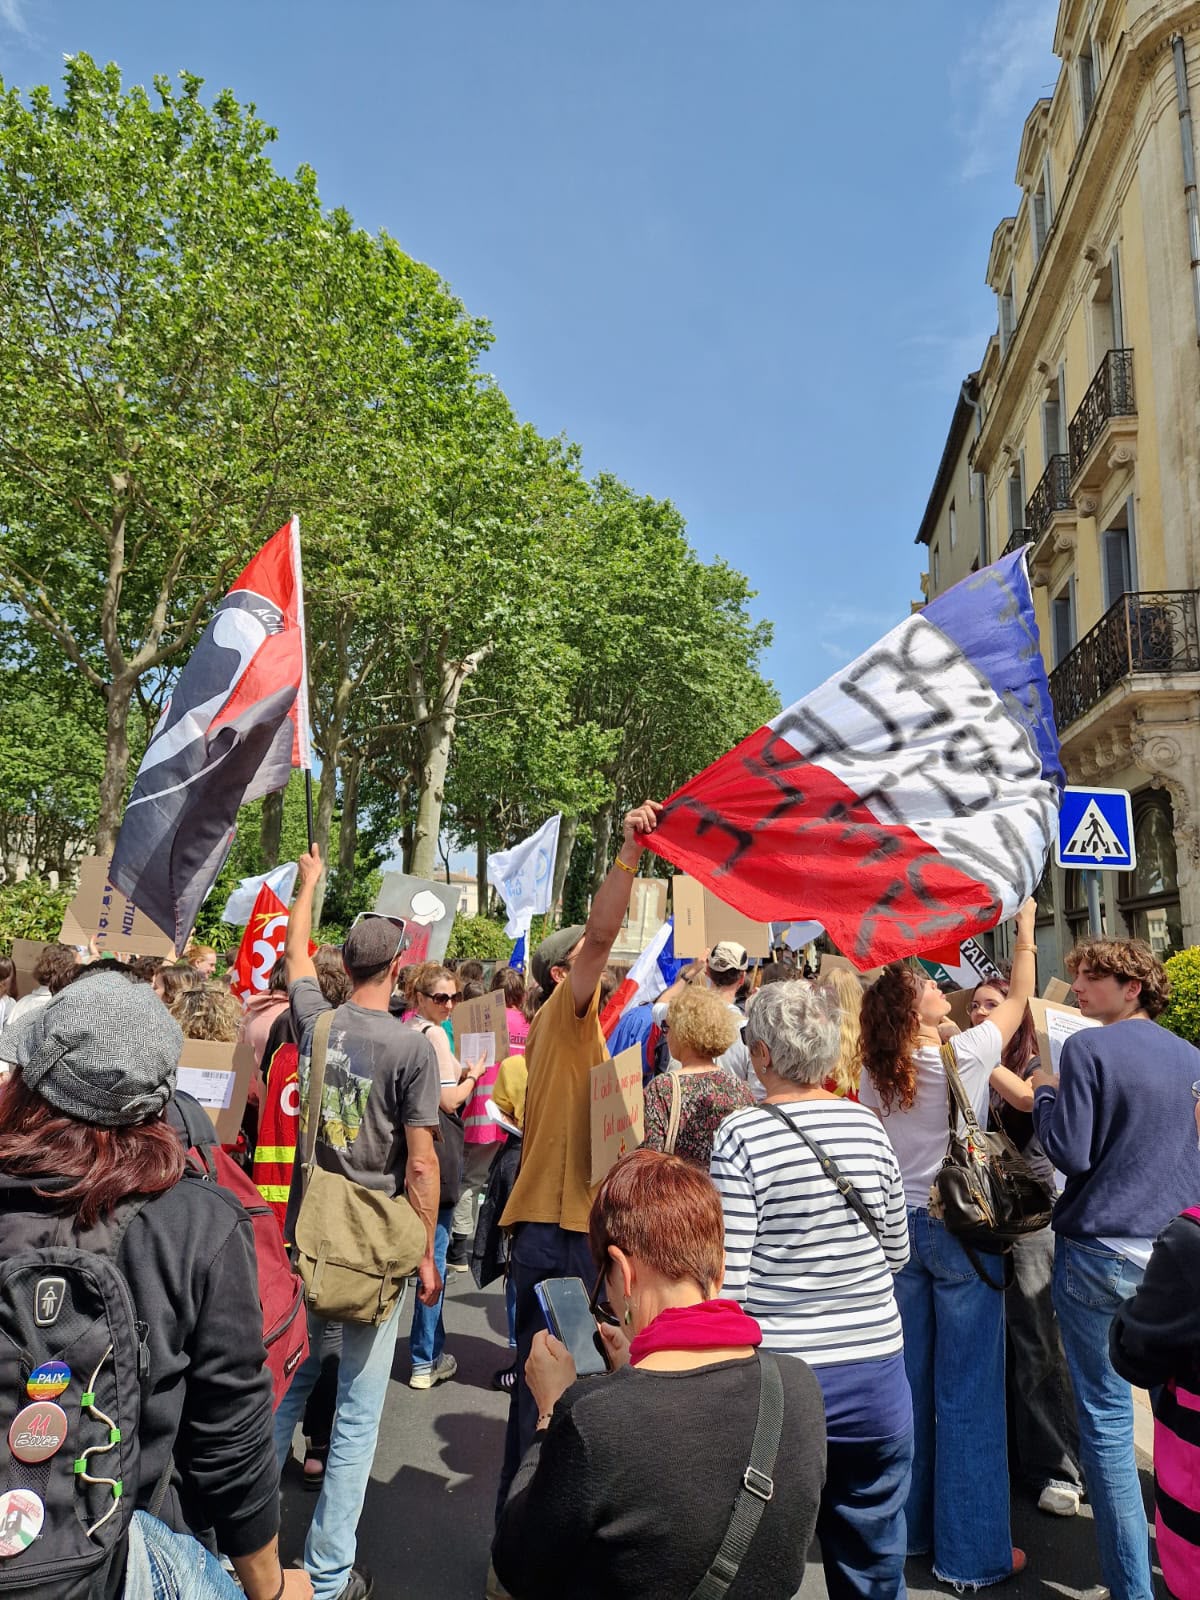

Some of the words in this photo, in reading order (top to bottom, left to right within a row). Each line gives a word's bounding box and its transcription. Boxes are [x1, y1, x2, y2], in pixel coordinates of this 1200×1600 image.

[121, 897, 136, 936] TION
[960, 937, 1001, 980] PALES
[37, 1373, 65, 1384] PAIX
[28, 1414, 52, 1437] 11
